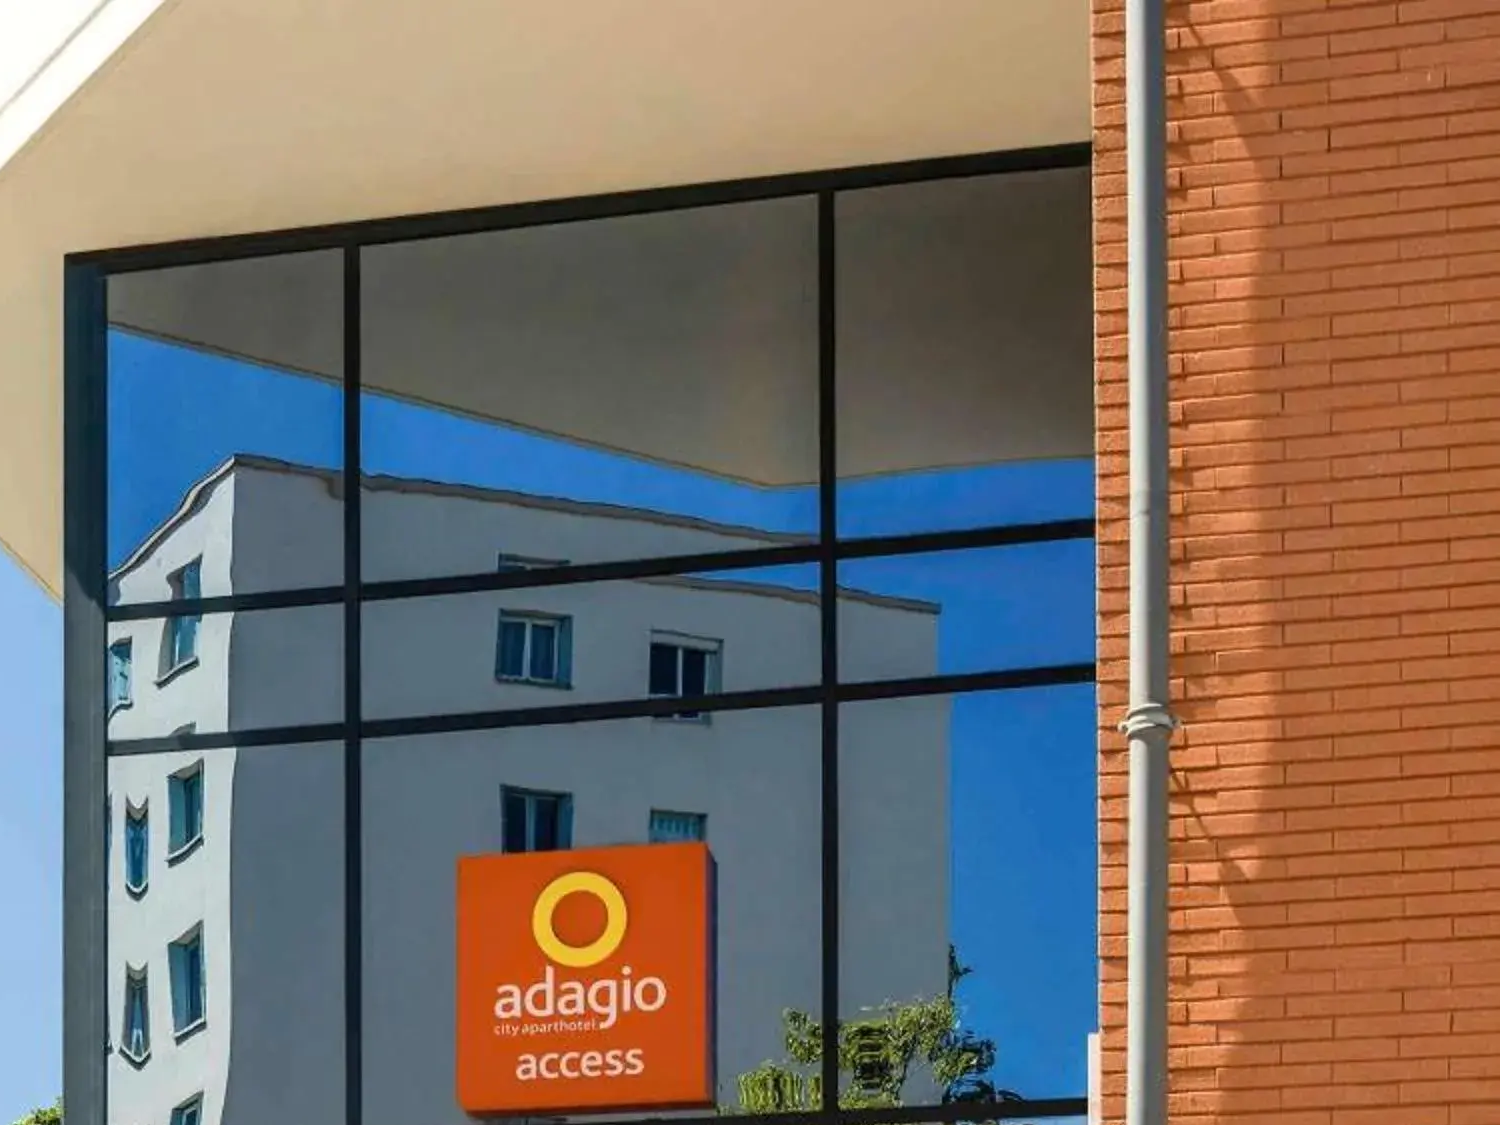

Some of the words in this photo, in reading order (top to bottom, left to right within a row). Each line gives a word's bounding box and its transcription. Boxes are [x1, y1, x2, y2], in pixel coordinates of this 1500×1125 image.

[494, 965, 667, 1029] adagio
[493, 1023, 520, 1036] city
[521, 1019, 596, 1034] aparthotel
[515, 1049, 645, 1081] access
